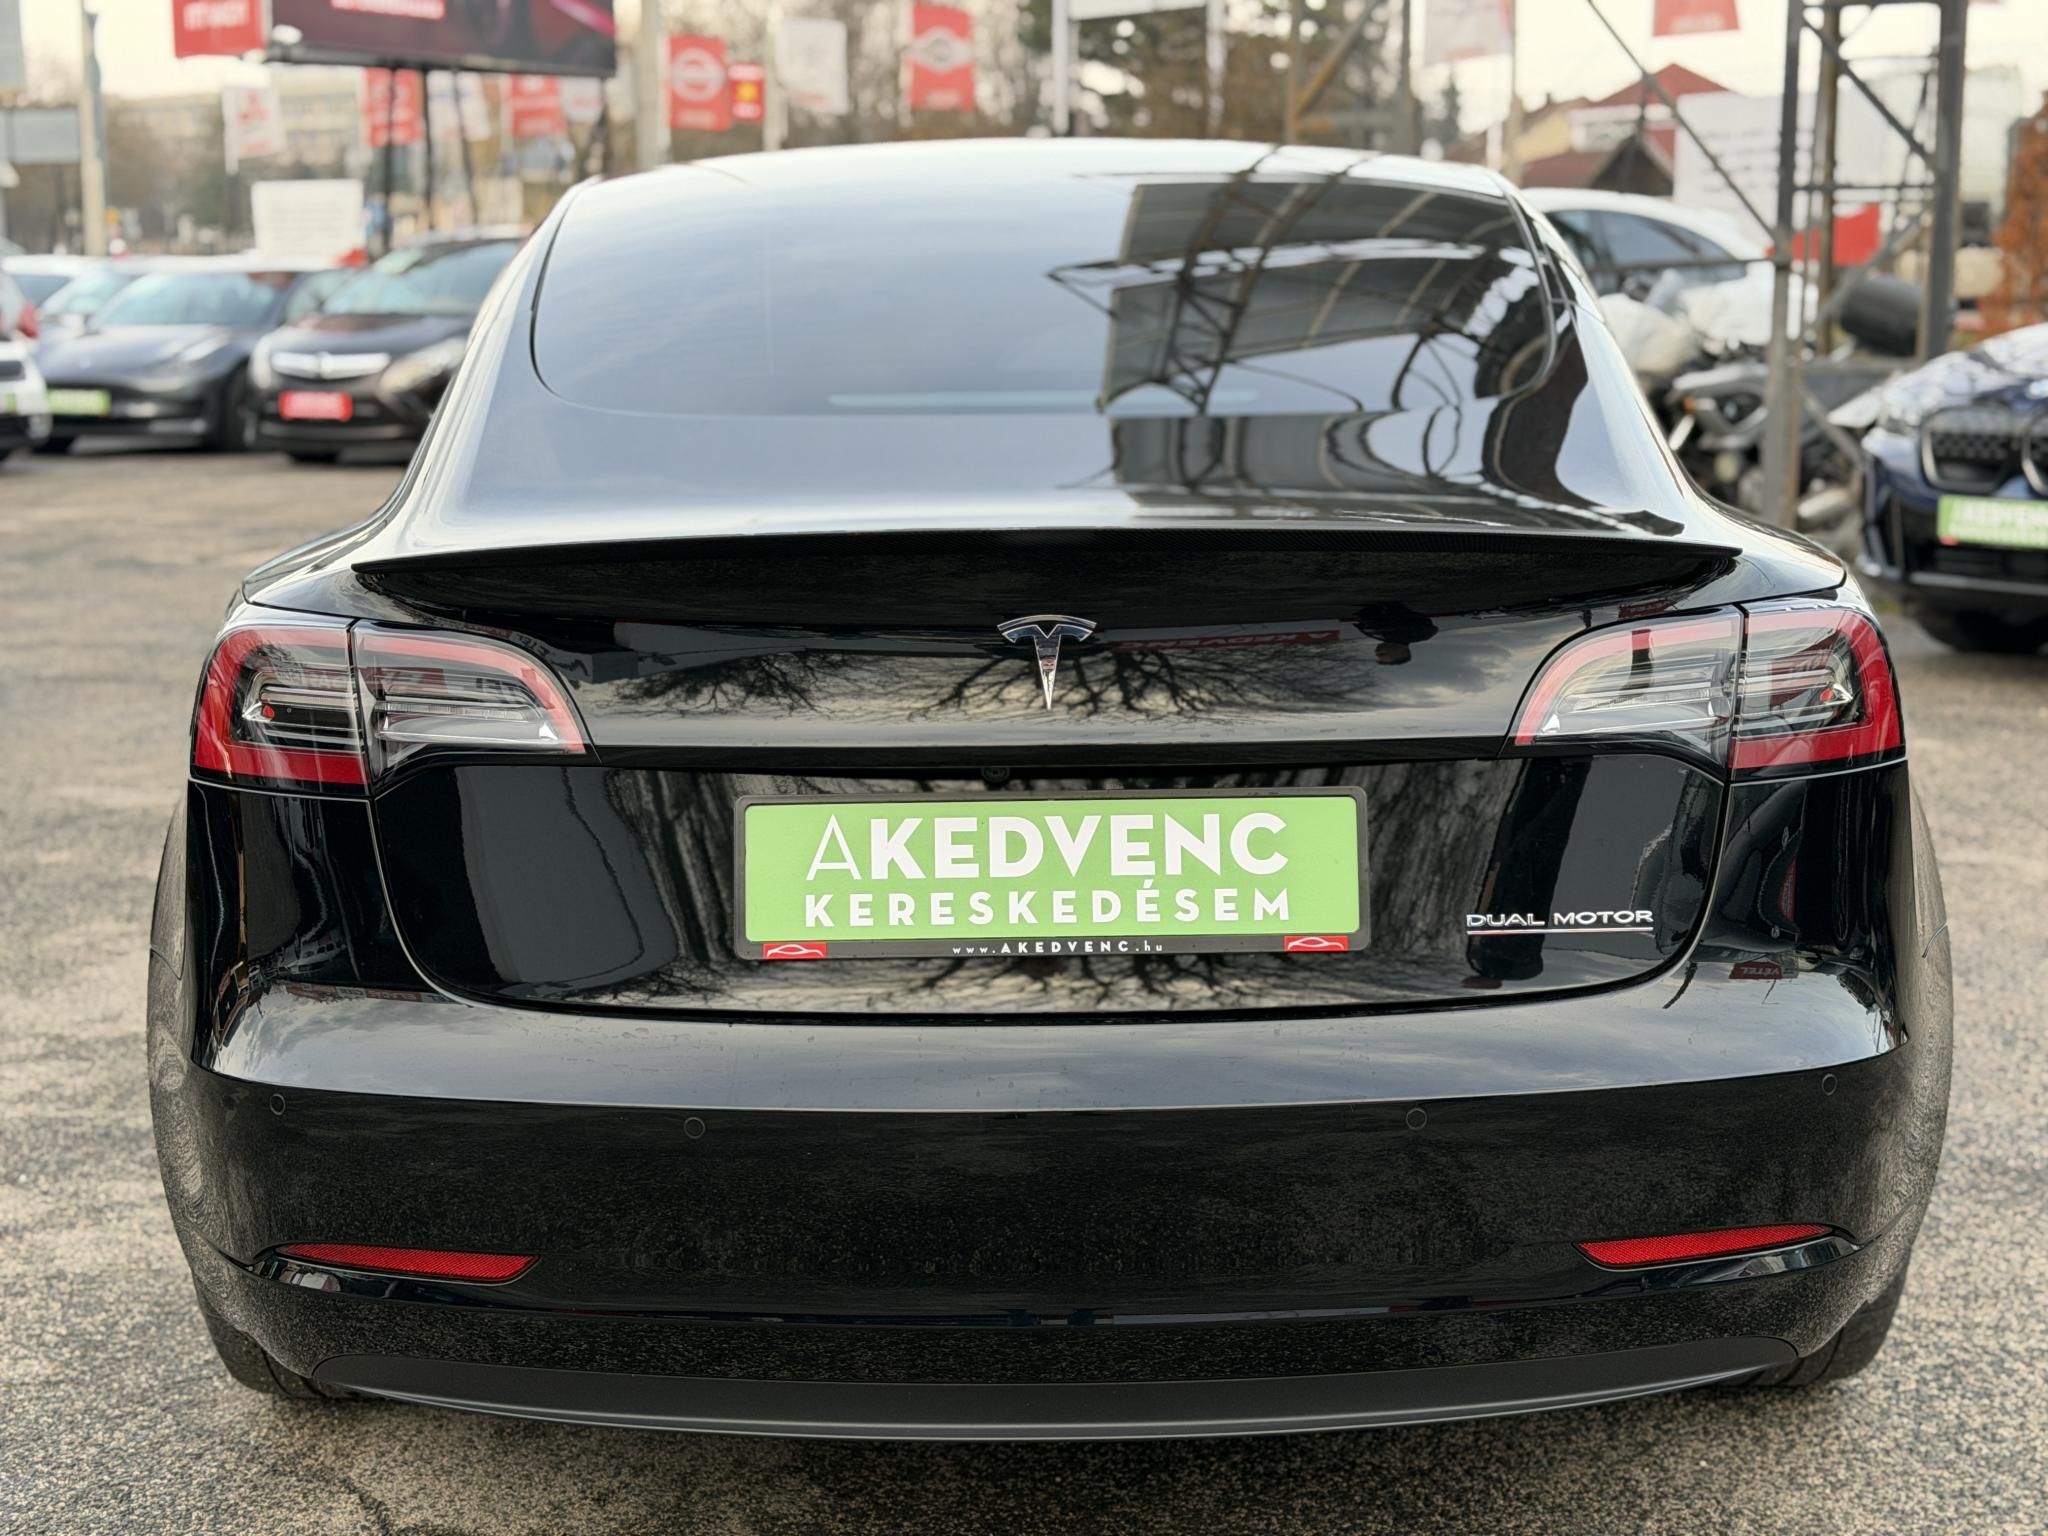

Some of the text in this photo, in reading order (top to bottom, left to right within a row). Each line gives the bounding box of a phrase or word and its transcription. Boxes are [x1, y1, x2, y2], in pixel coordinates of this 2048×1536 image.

[804, 880, 1290, 928] KERESKEDÉSEM
[1466, 910, 1654, 927] DUAL MOTOR
[953, 939, 1163, 954] www.AKEDVENC.hu
